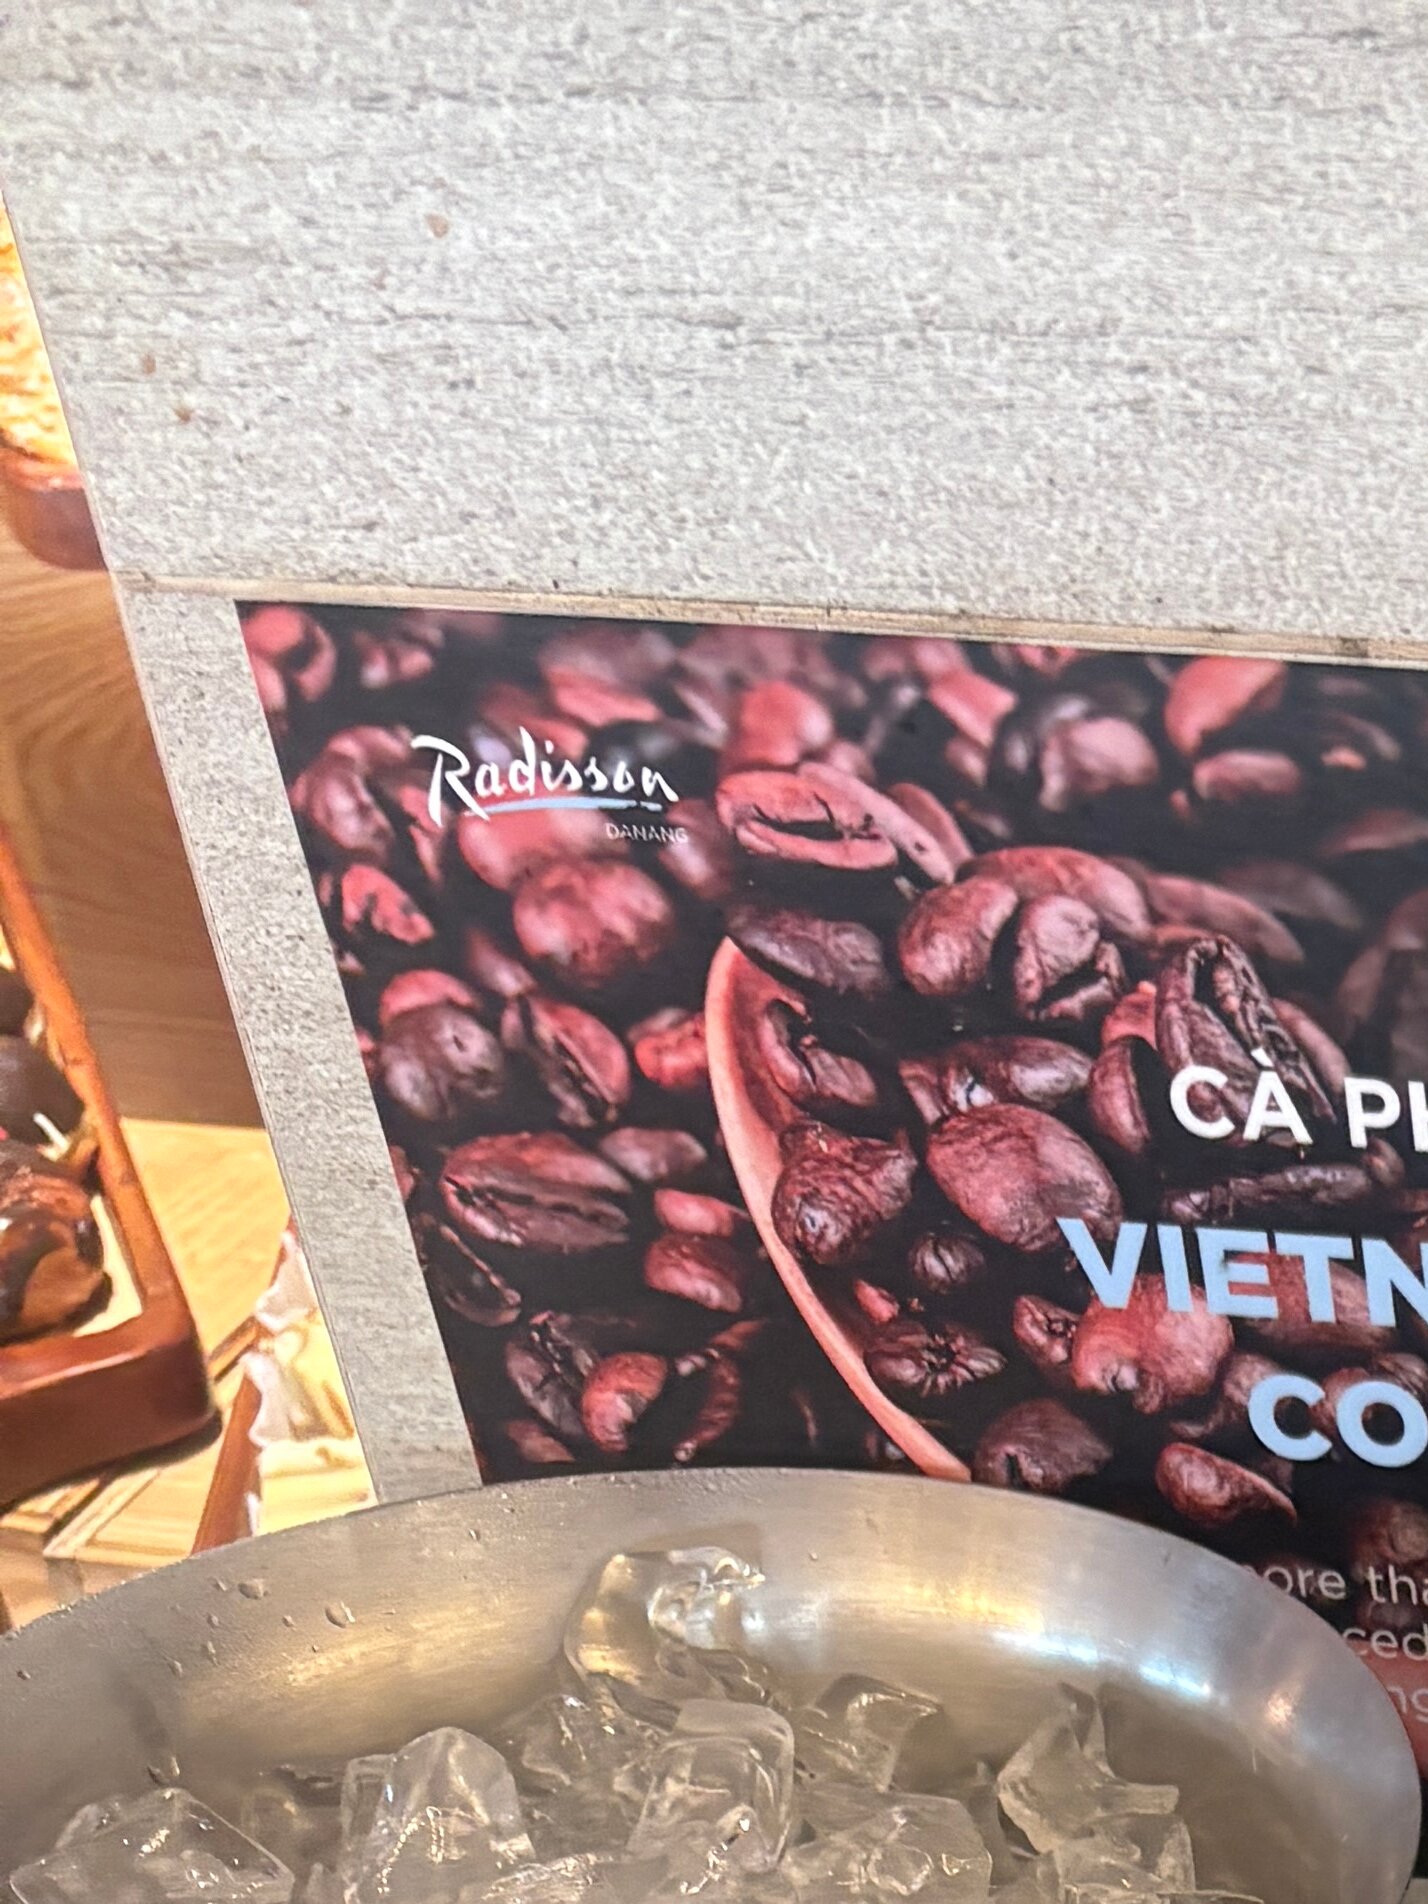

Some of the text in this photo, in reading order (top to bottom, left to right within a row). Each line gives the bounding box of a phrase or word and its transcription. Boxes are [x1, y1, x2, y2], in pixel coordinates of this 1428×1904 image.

[411, 727, 679, 828] Radisson
[605, 822, 689, 843] DANANG
[1168, 1048, 1313, 1147] CÀ
[1244, 1563, 1347, 1600] ore
